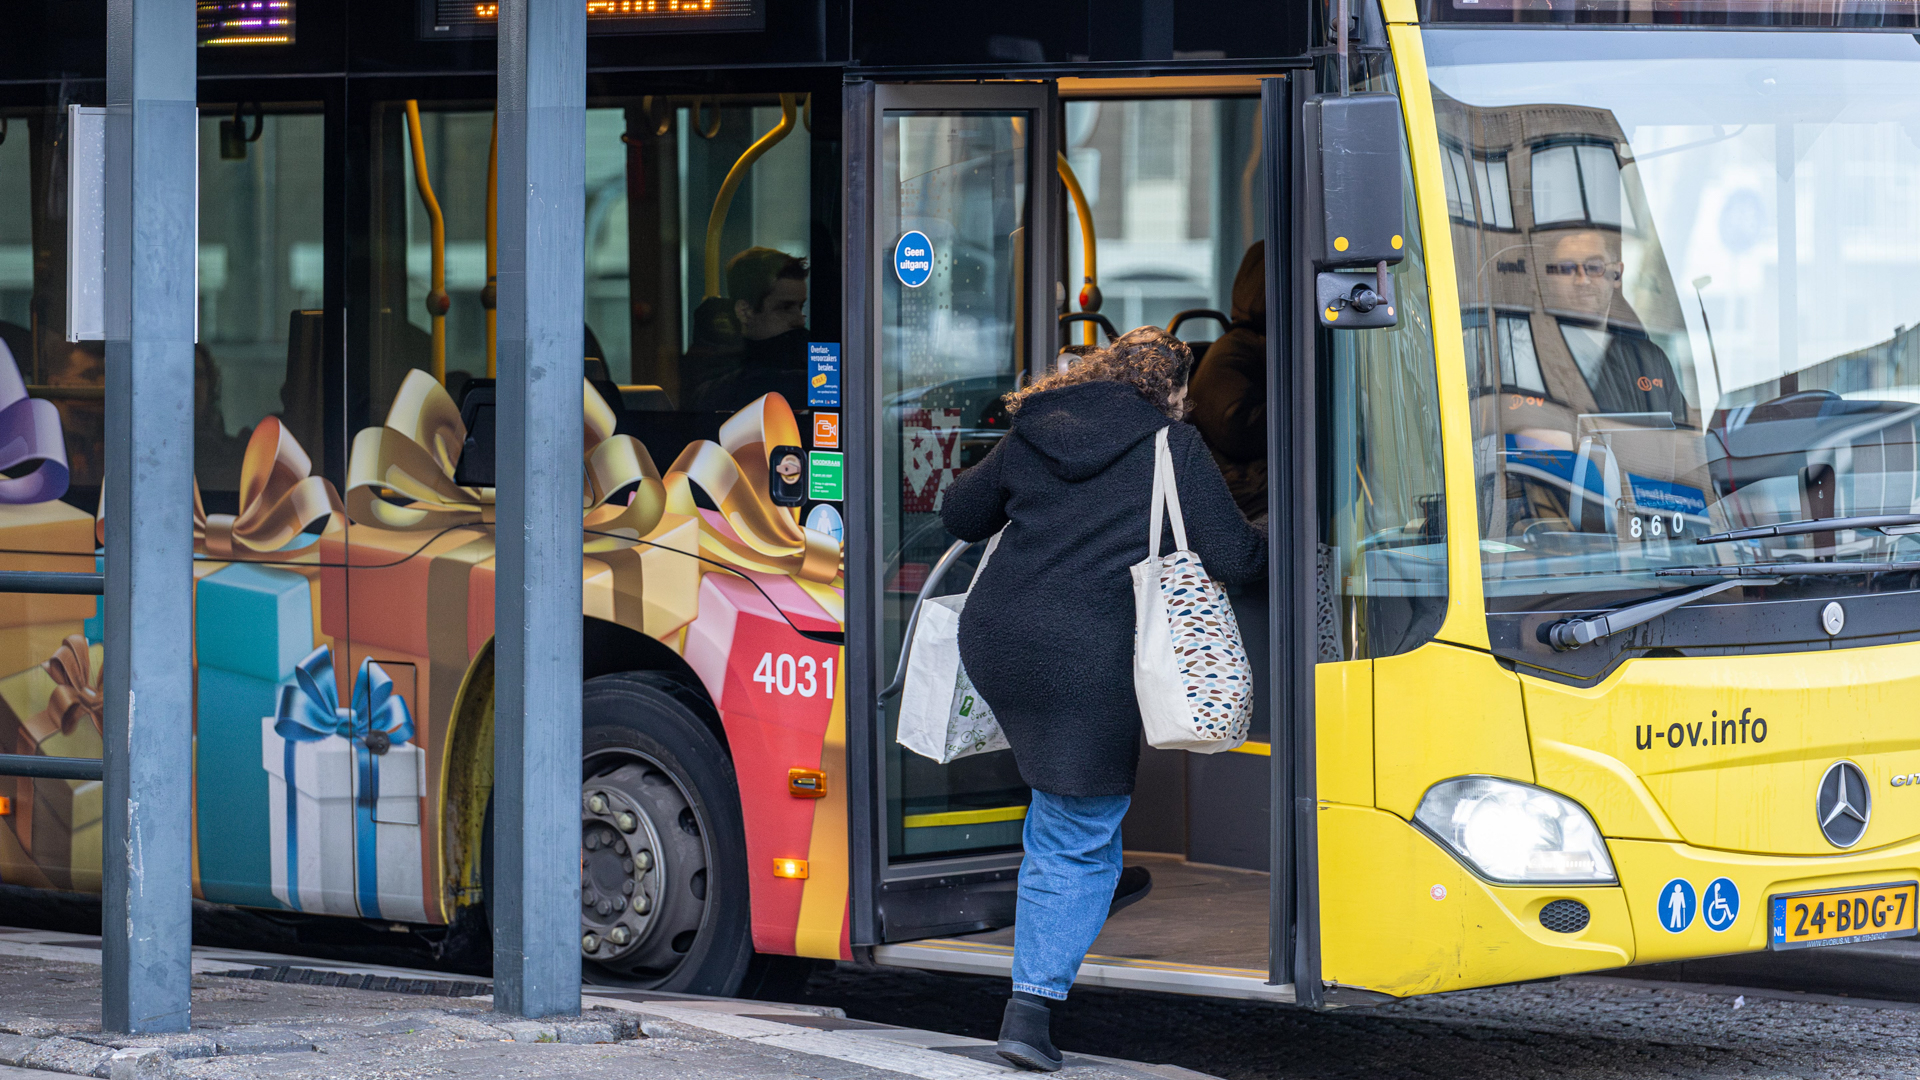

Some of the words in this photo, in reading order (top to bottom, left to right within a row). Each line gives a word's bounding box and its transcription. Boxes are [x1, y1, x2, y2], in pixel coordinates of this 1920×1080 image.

[900, 260, 929, 271] uitgang
[904, 247, 925, 257] Geen
[753, 652, 834, 700] 4031
[1635, 707, 1767, 750] u-ov.info
[1794, 893, 1909, 936] 24-BDG-7
[1773, 926, 1784, 937] NL
